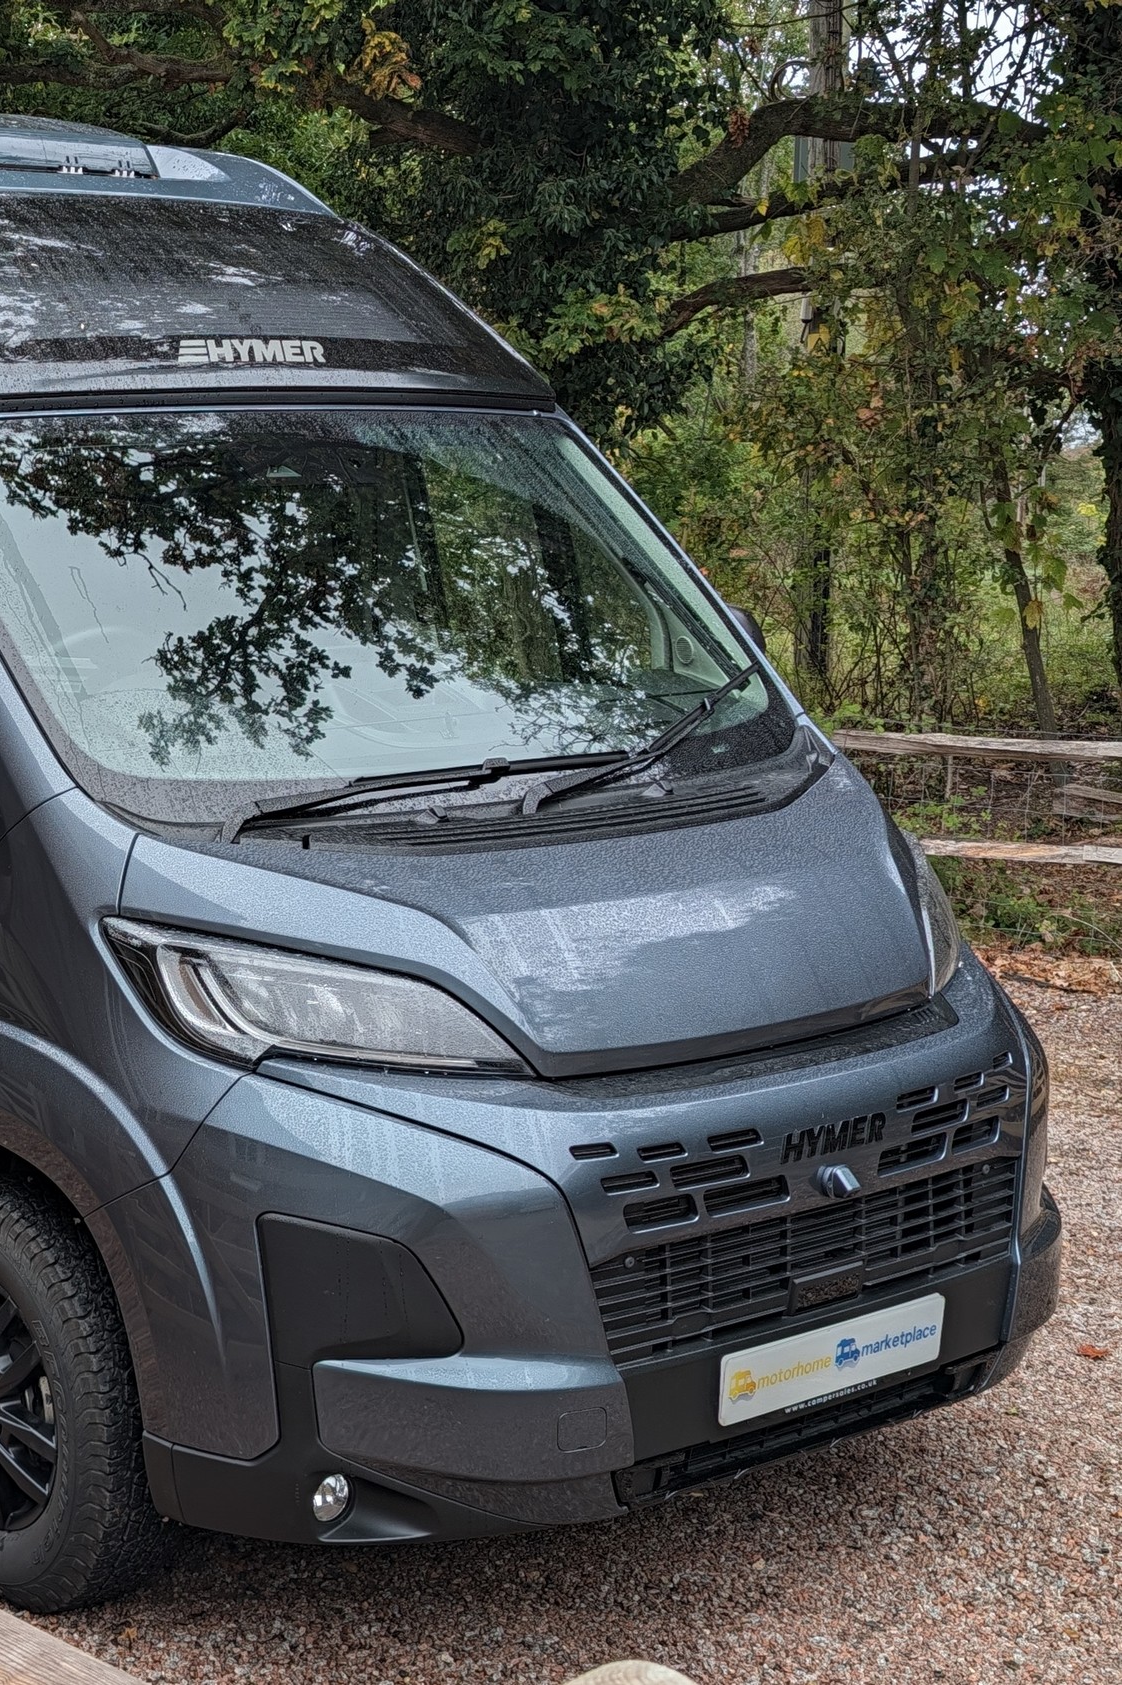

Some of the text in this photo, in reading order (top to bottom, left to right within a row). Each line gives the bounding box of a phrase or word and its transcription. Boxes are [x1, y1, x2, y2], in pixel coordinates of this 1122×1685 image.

[206, 339, 326, 362] HYMER
[780, 1112, 886, 1165] HYMER
[757, 1323, 937, 1390] motorhome marketplace
[784, 1379, 877, 1415] www.campersales.co.uk
